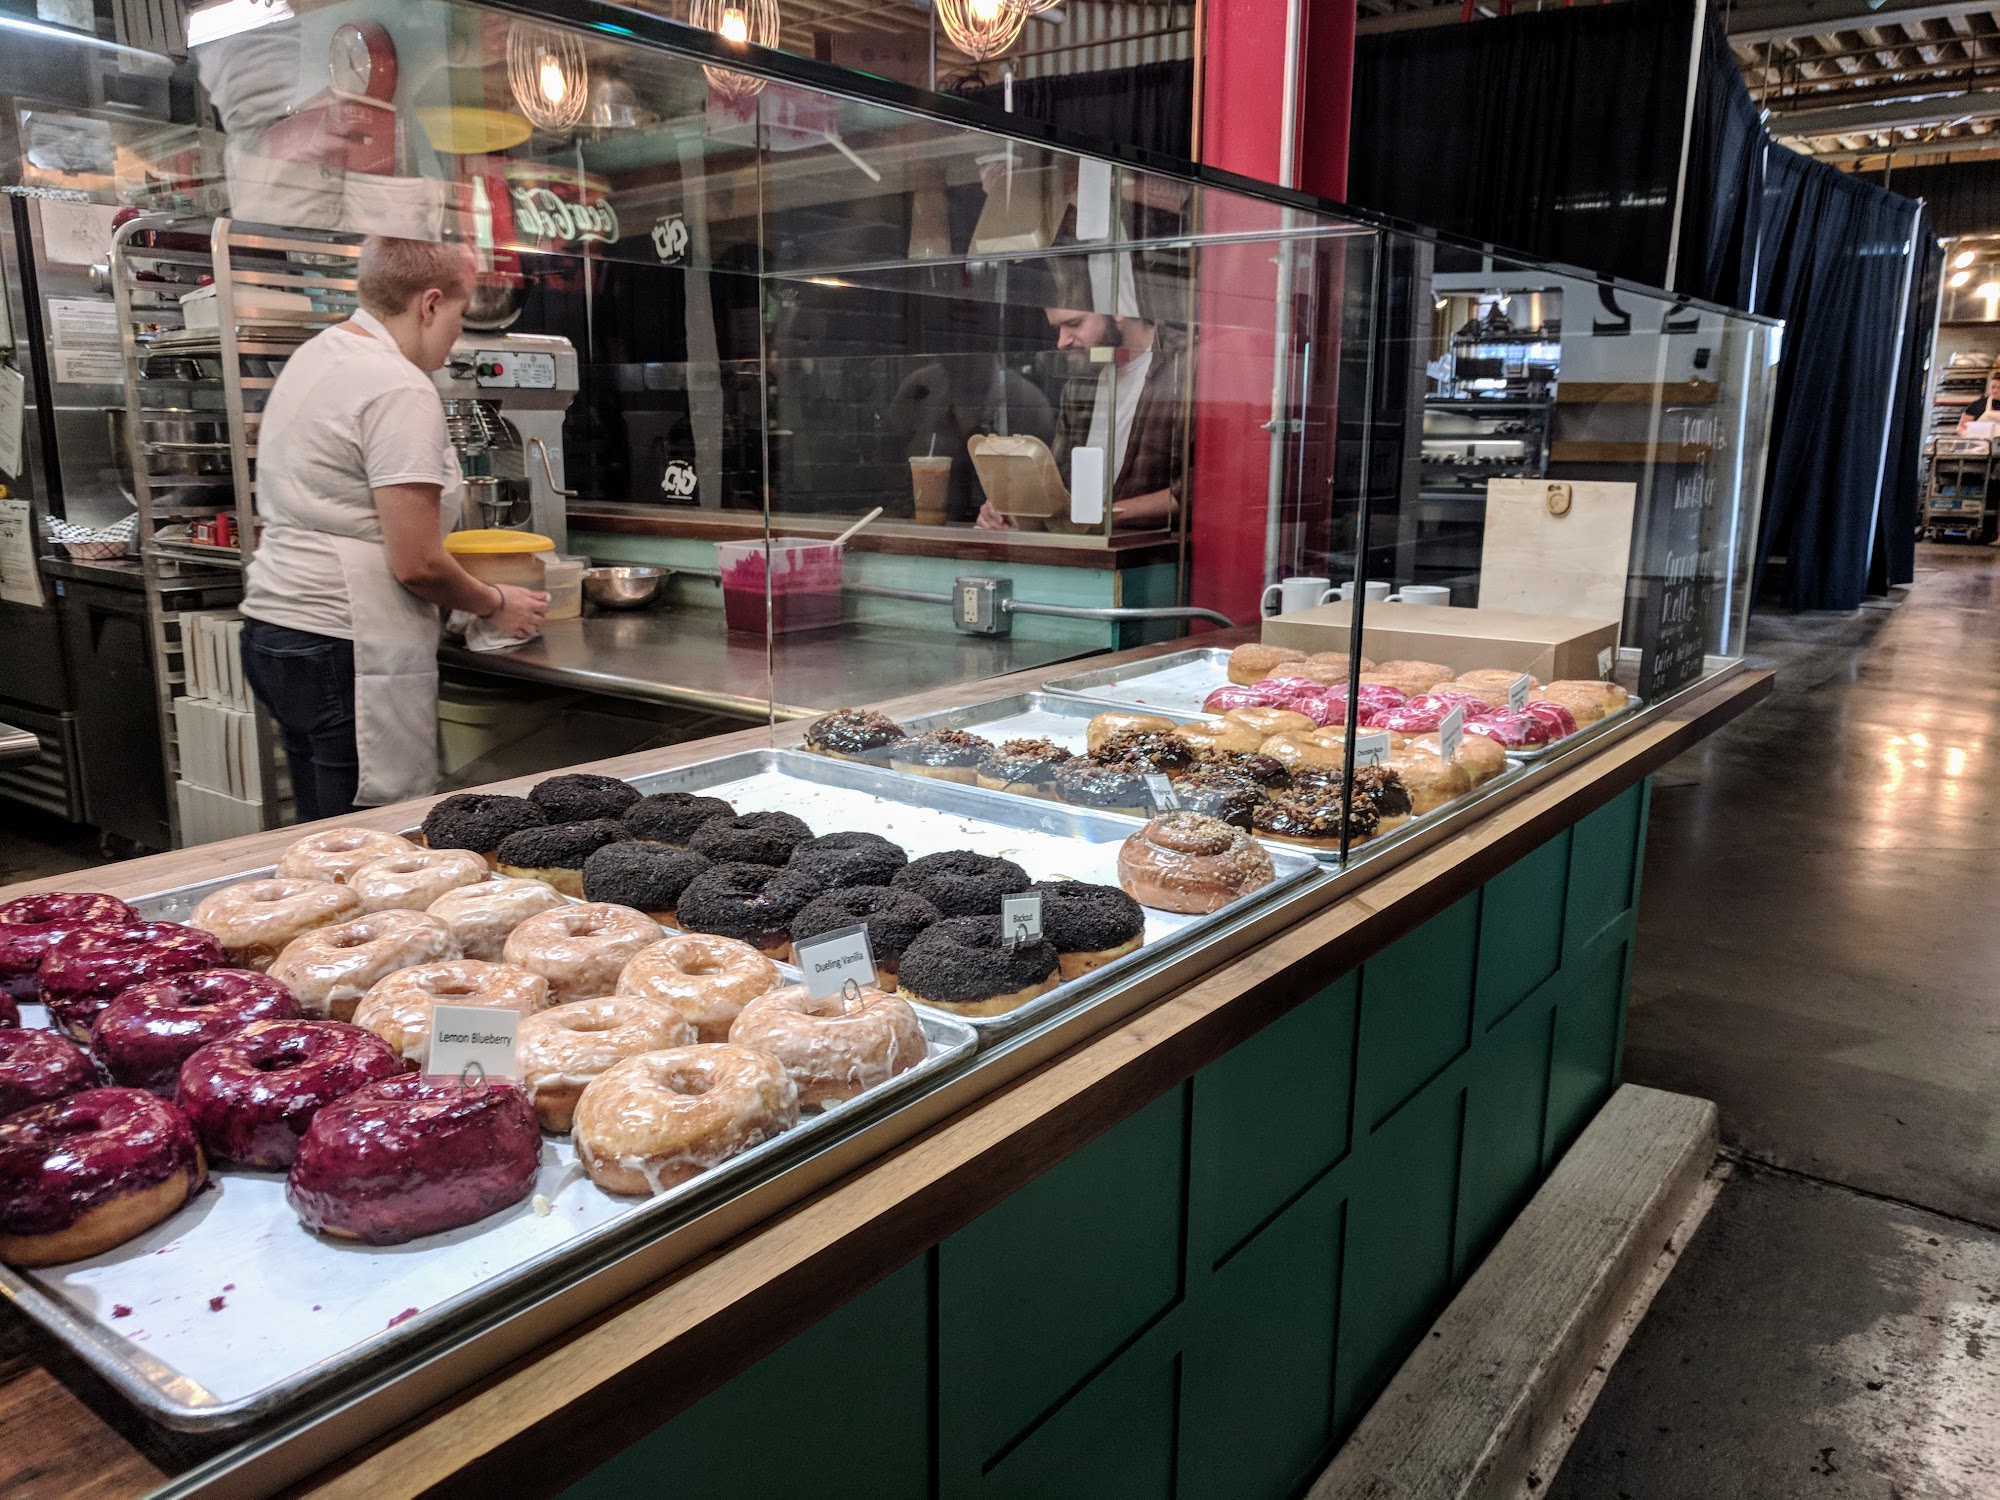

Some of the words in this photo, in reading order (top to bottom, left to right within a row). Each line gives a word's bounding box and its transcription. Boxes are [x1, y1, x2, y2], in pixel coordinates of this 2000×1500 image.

[814, 958, 842, 973] Dueling
[841, 951, 864, 965] Vanilla
[439, 1031, 469, 1043] Lemon
[471, 1032, 512, 1047] Blueberry
